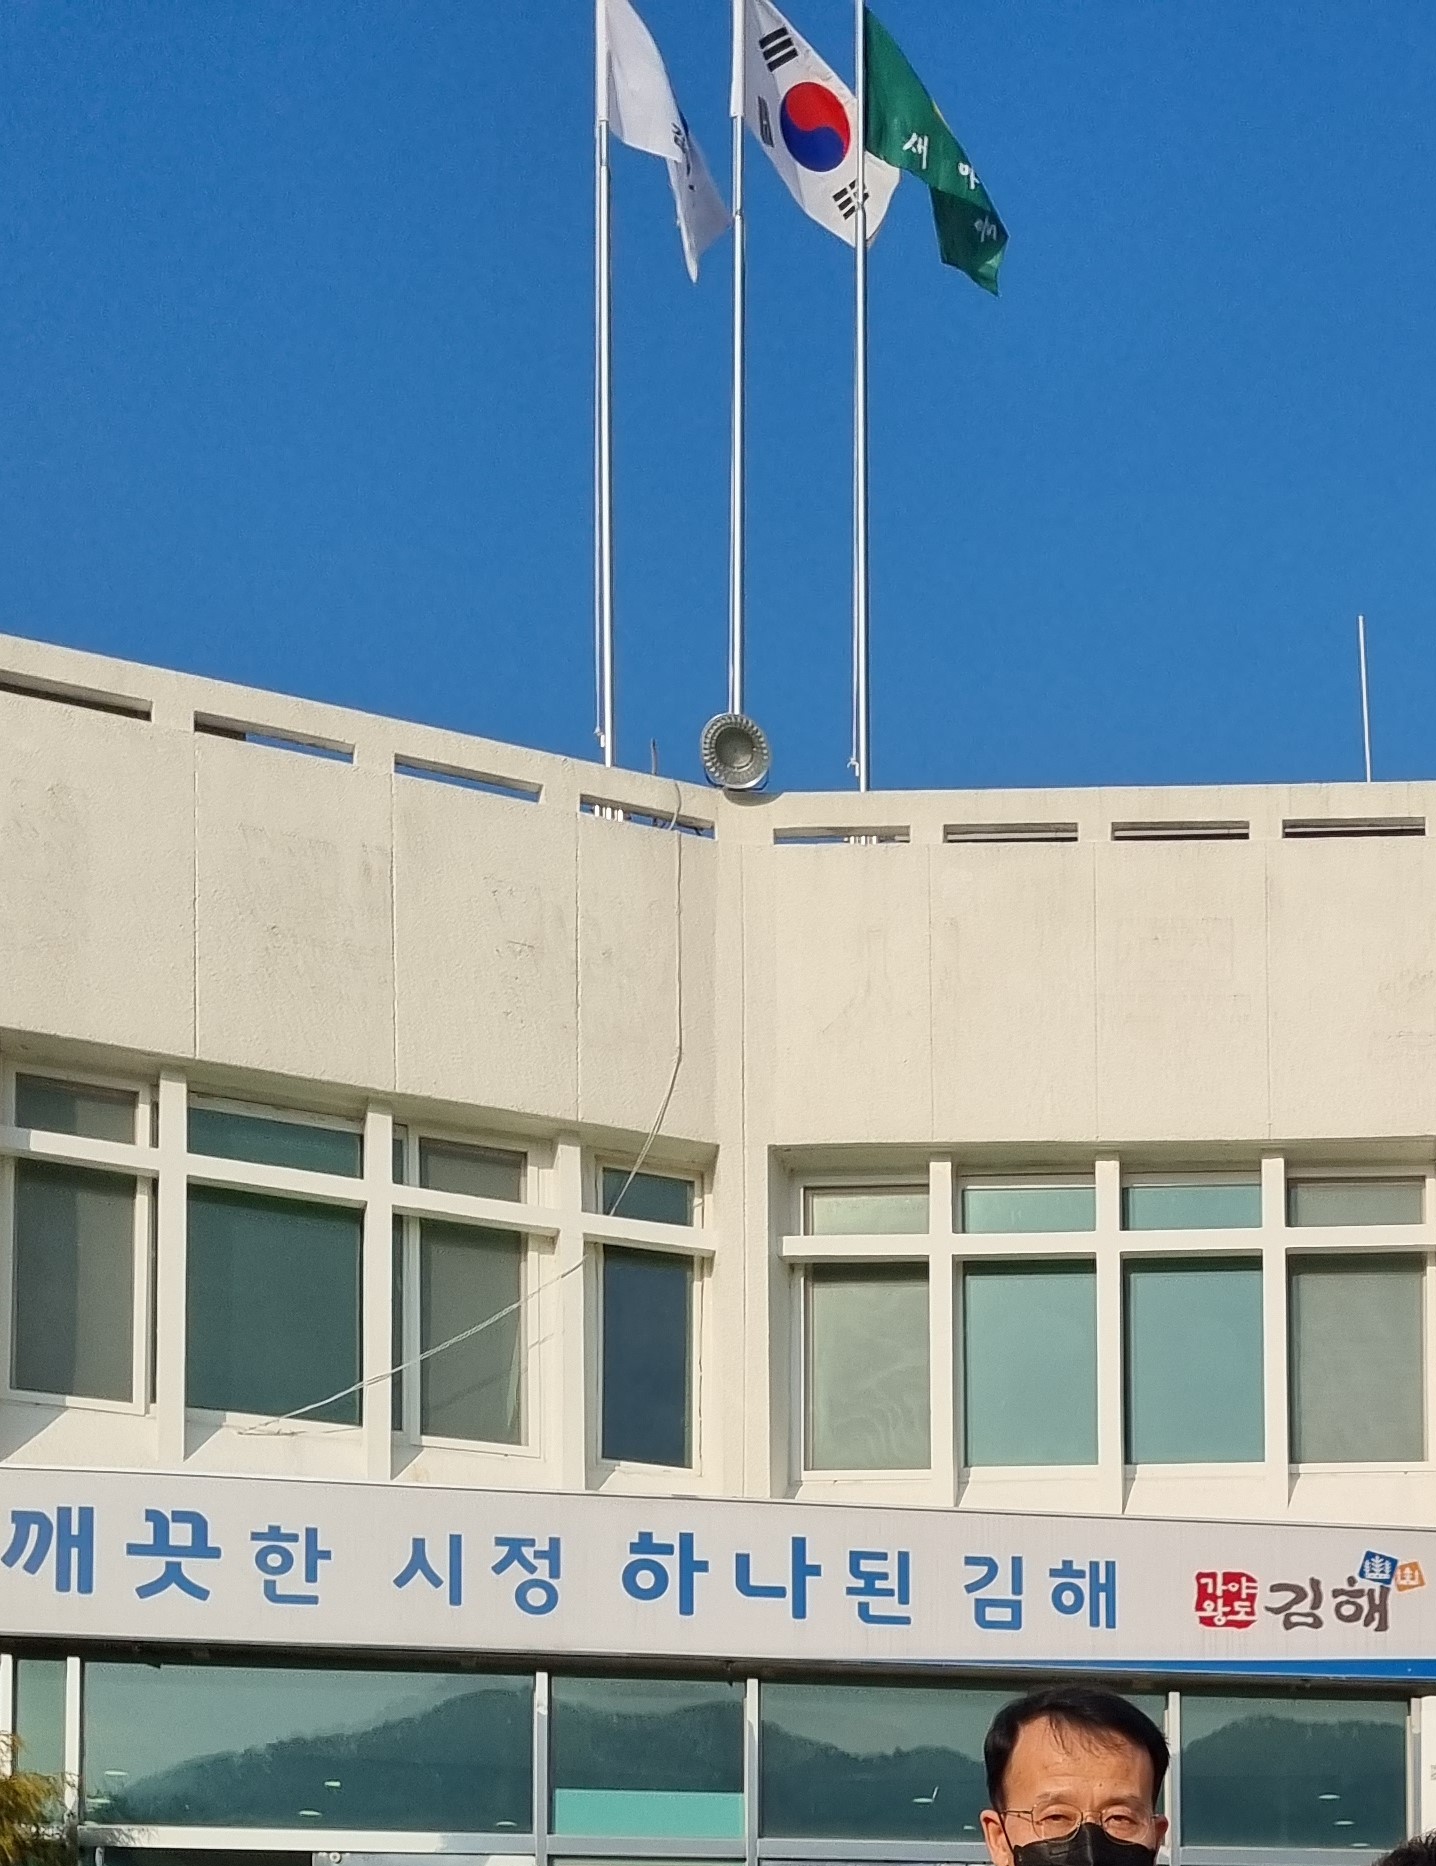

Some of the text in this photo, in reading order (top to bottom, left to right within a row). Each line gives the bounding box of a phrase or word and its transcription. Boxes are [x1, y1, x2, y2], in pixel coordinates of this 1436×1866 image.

[1, 1506, 1118, 1631] 깨끗한 시정 하나된 김해
[1264, 1575, 1391, 1632] 김해
